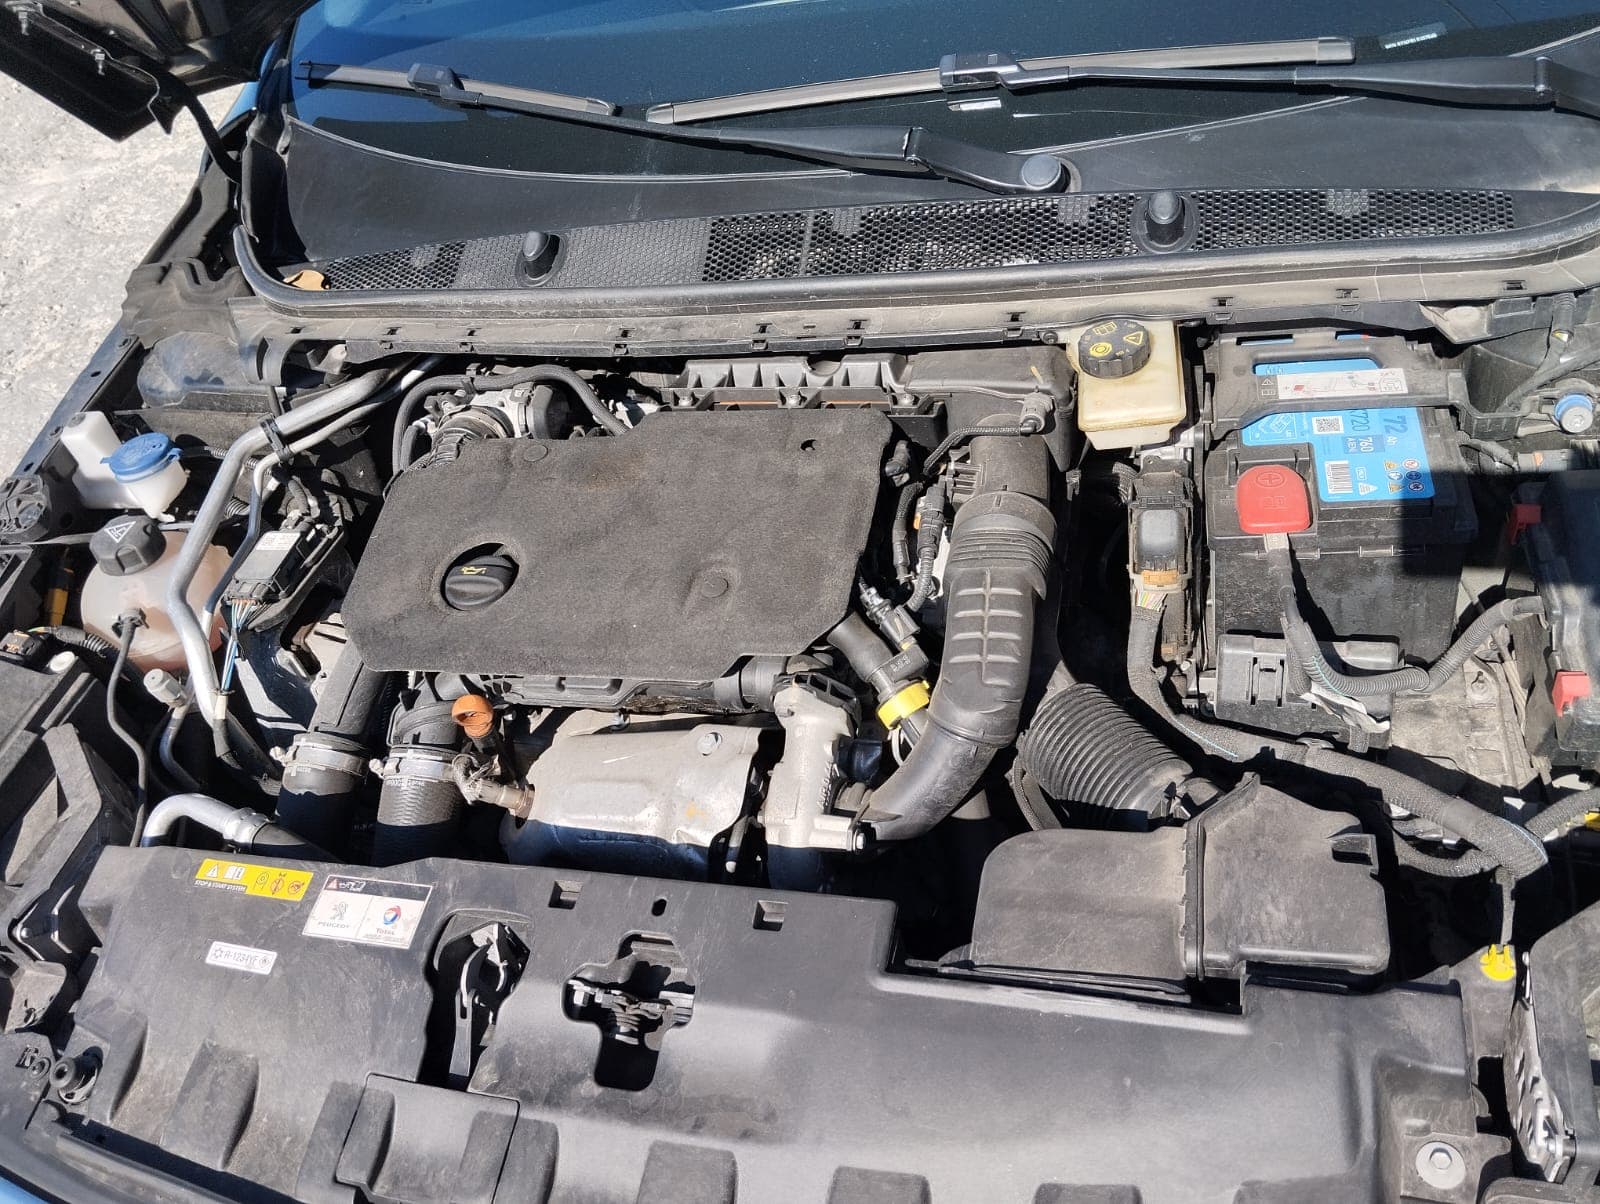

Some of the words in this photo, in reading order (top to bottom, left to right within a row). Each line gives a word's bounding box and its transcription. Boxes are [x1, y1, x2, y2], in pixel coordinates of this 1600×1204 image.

[1383, 415, 1408, 433] 72
[1359, 436, 1374, 453] 760
[1386, 435, 1398, 446] Ah
[227, 884, 246, 892] SYSTEM
[318, 921, 349, 929] PEUGEOT
[376, 927, 395, 936] TOTAL
